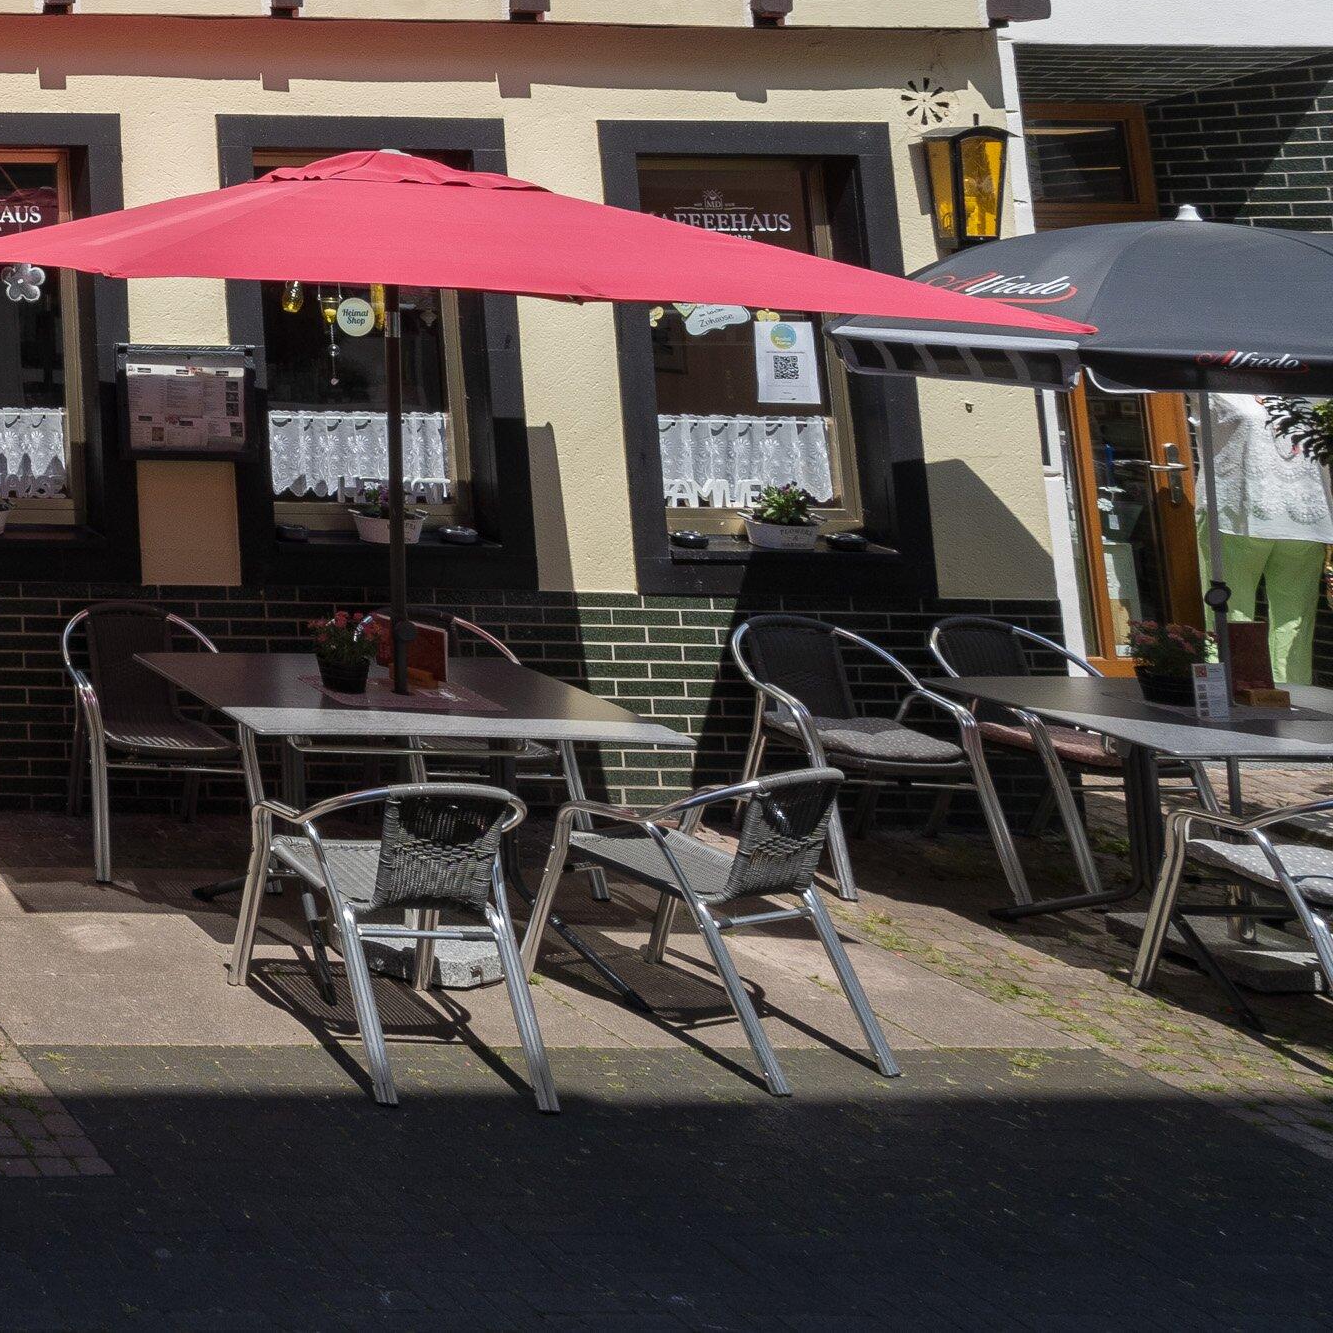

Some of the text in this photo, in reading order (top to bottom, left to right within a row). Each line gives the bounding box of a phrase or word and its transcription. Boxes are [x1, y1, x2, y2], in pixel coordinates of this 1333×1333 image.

[661, 212, 792, 232] FFEEHAUS
[927, 270, 1079, 304] Alfredo
[346, 316, 366, 326] Shop
[1194, 348, 1310, 374] Alfredo
